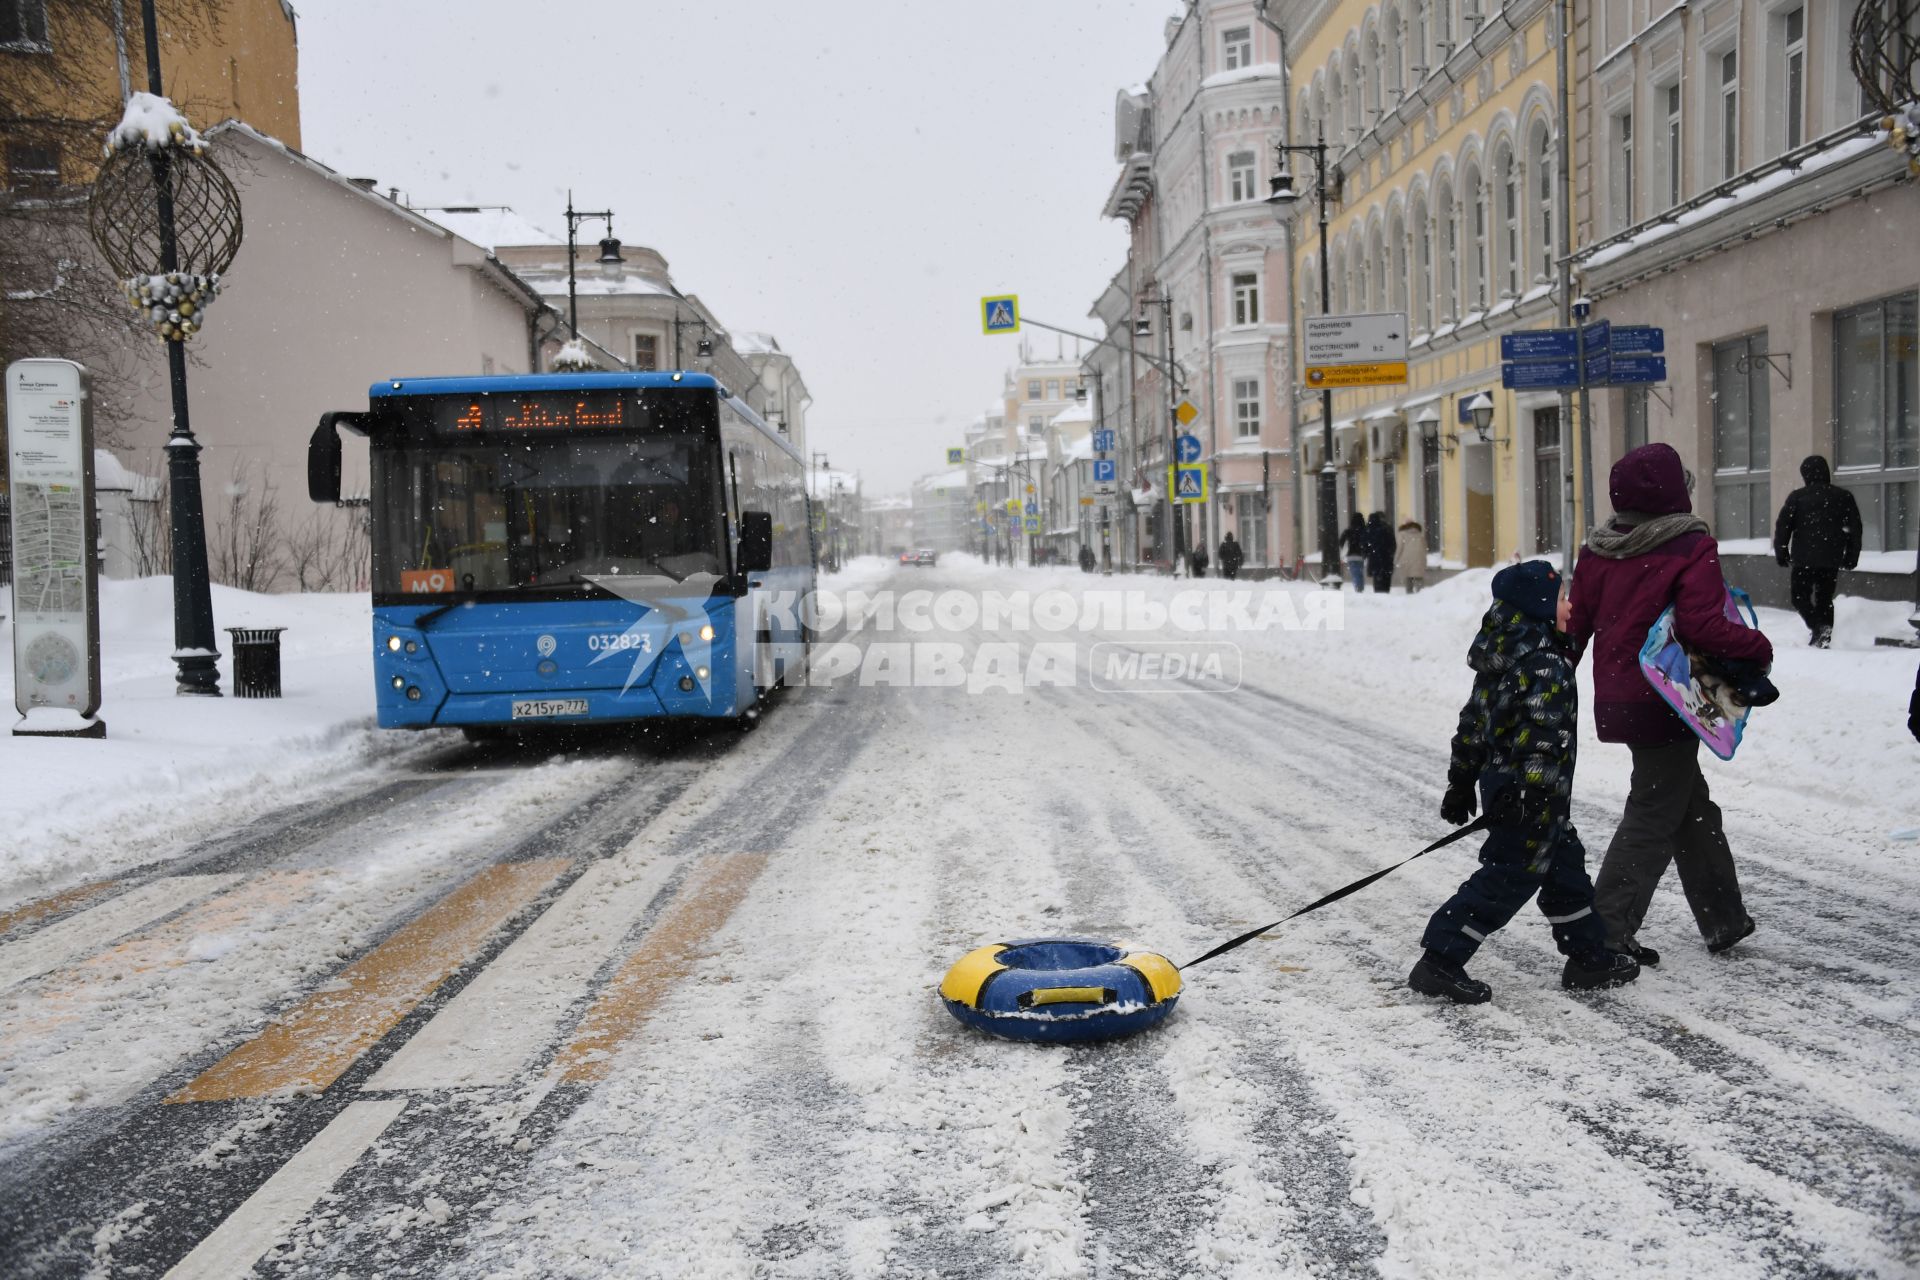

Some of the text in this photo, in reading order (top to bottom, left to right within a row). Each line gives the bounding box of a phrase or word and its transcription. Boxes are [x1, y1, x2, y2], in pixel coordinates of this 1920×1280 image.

[1308, 321, 1352, 330] РЫБНИКОВ
[1310, 342, 1359, 352] КОСТЯНСКИЙ
[588, 633, 652, 651] 032823
